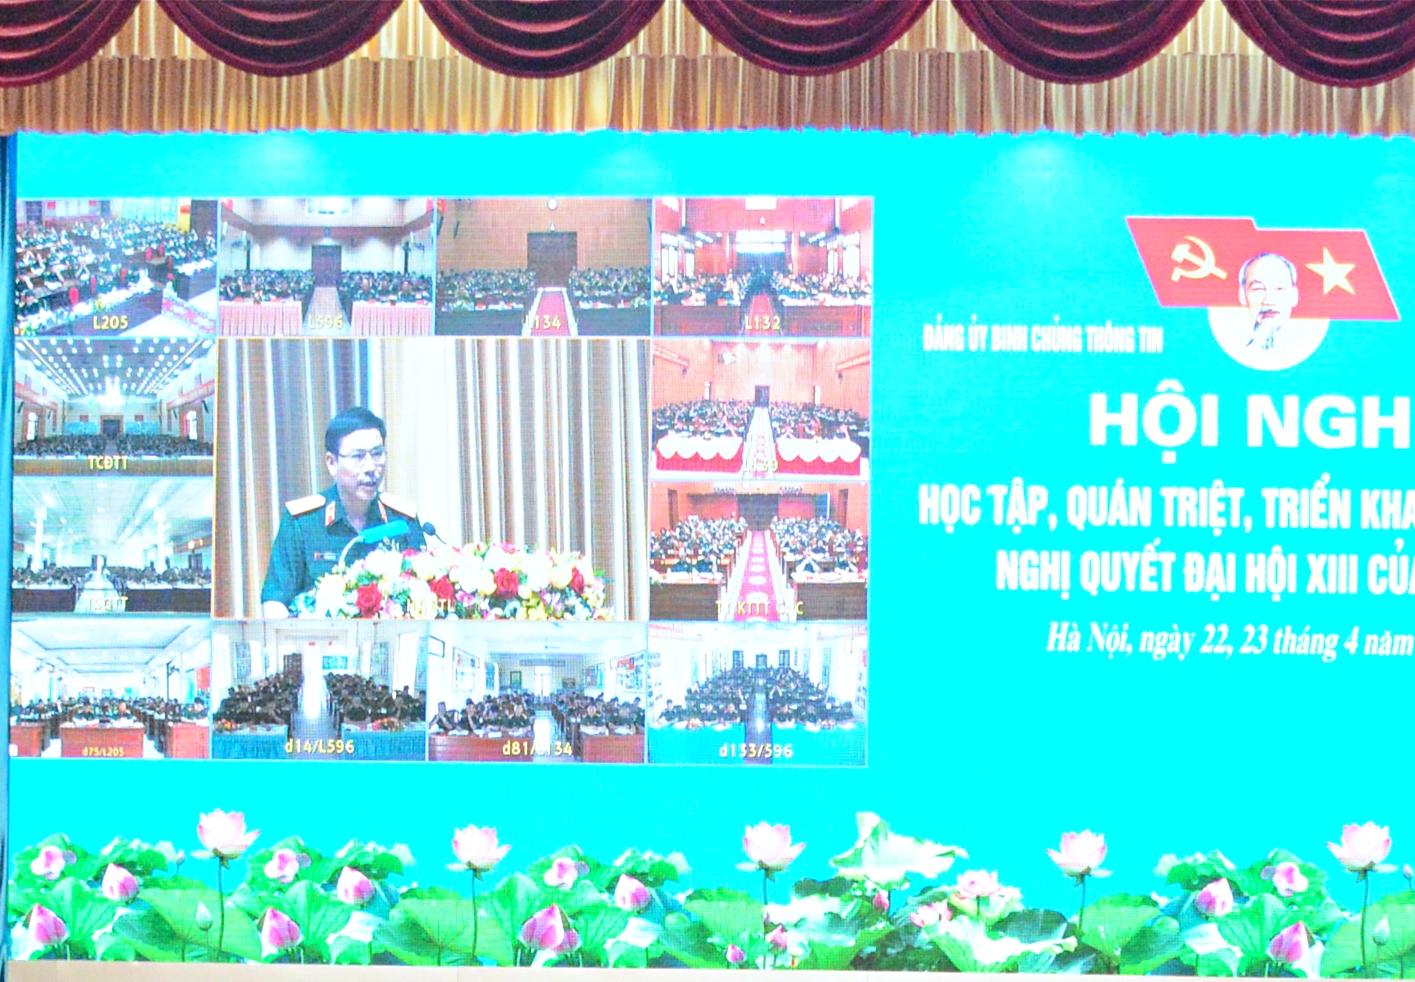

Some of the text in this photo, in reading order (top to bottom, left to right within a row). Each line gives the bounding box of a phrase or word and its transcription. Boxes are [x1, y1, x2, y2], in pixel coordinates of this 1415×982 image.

[92, 315, 129, 330] L205
[744, 314, 781, 330] L132
[1090, 378, 1218, 463] HỘI
[919, 484, 980, 533] HỌC
[987, 477, 1057, 533] TẬP,
[1067, 478, 1151, 530] QUÁN
[1161, 480, 1252, 536] TRIỆT,
[1262, 472, 1350, 528] TRIỂN
[997, 550, 1070, 599] NGHỊ
[1081, 539, 1176, 595] QUYẾT
[1183, 553, 1235, 601] ĐẠI
[1246, 545, 1296, 601] HỘI
[1307, 554, 1358, 593] XIII
[1047, 622, 1080, 651] Hà
[1087, 623, 1132, 658] Nội,
[1140, 624, 1195, 660] ngày
[1200, 624, 1233, 655] 22,
[1240, 625, 1268, 654] 23
[1274, 626, 1339, 662] tháng
[1344, 626, 1358, 654] 4
[1364, 631, 1414, 655] năm
[284, 739, 355, 755] d14/L596
[719, 743, 794, 758] d133/596
